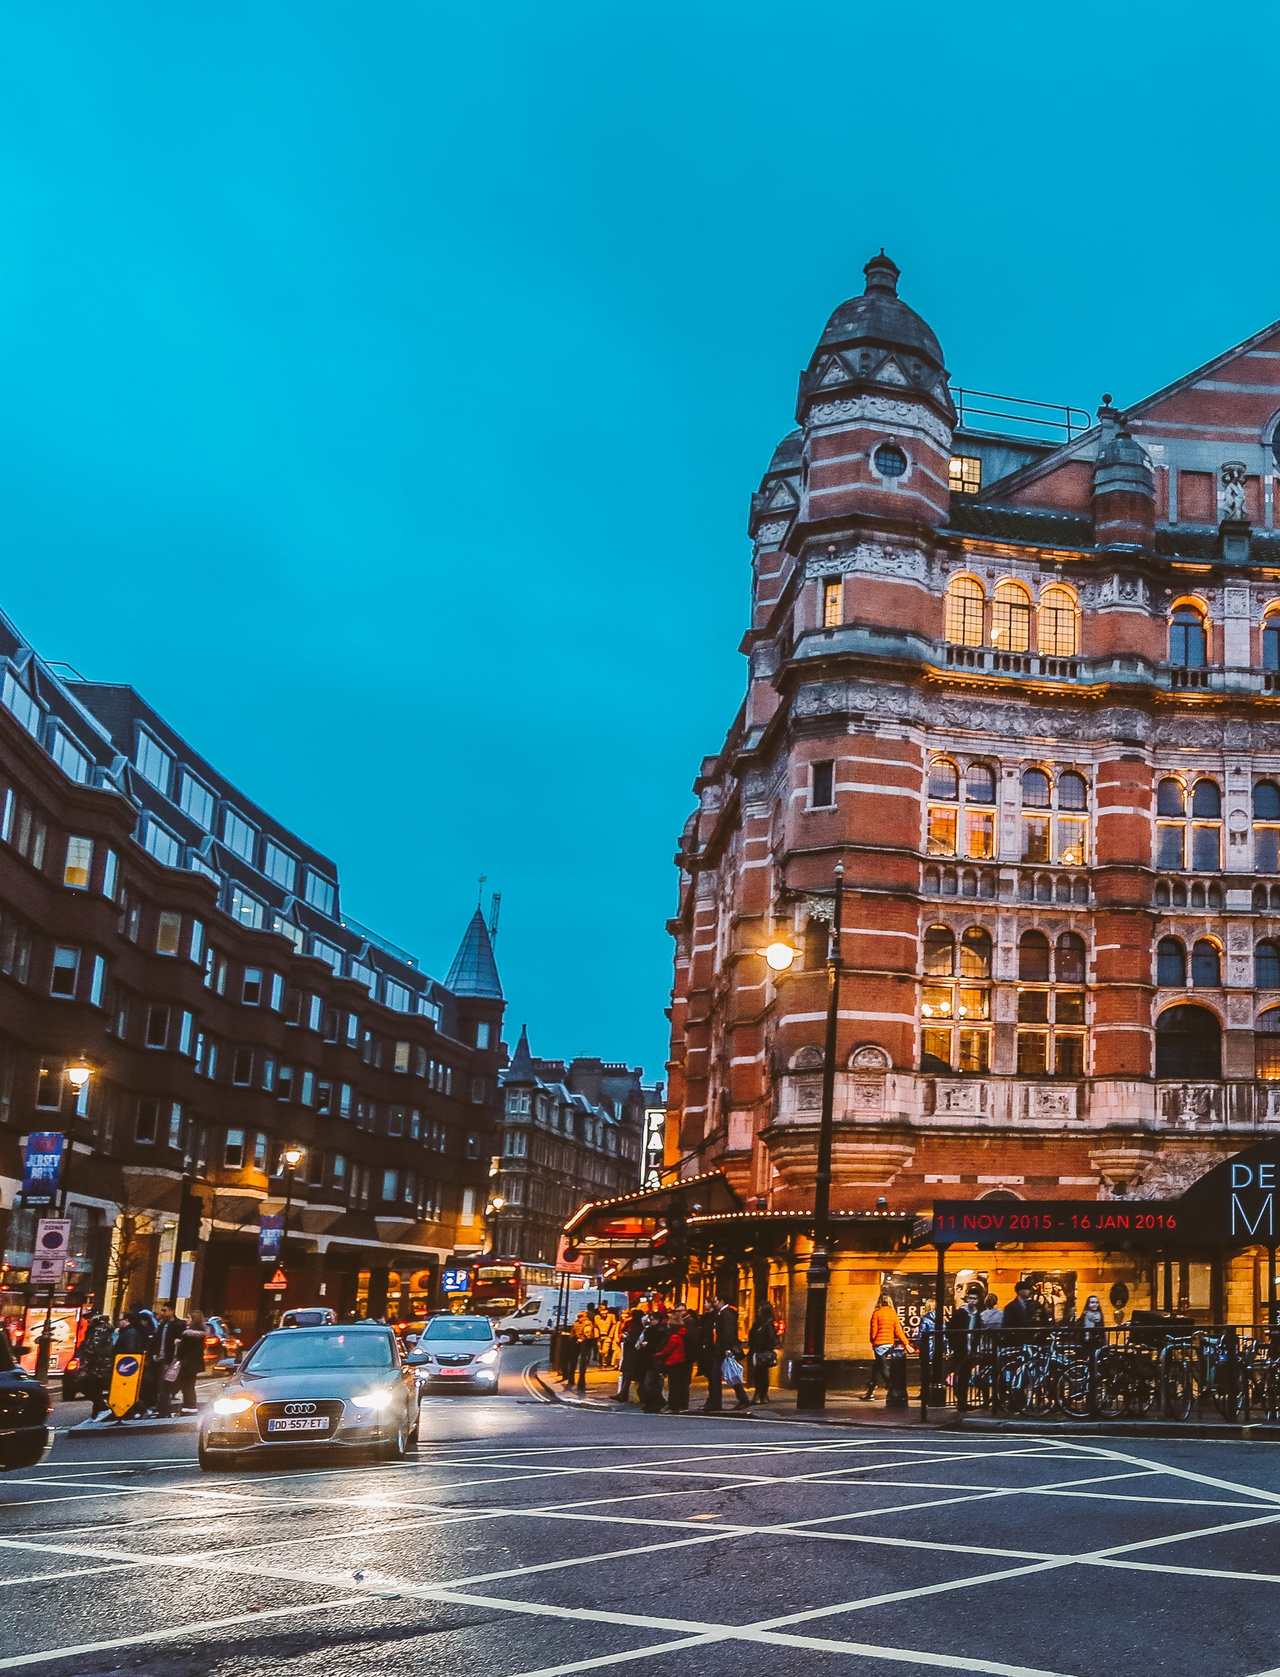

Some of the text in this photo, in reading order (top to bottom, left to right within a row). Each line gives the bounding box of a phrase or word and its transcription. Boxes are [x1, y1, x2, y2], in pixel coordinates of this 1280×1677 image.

[26, 1154, 61, 1168] JERSEY
[937, 1215, 955, 1229] 11
[963, 1215, 1005, 1229] NOV
[1009, 1215, 1052, 1230] 2015
[1071, 1215, 1091, 1229] 16
[1095, 1215, 1129, 1229] JAN
[1135, 1215, 1177, 1229] 2016
